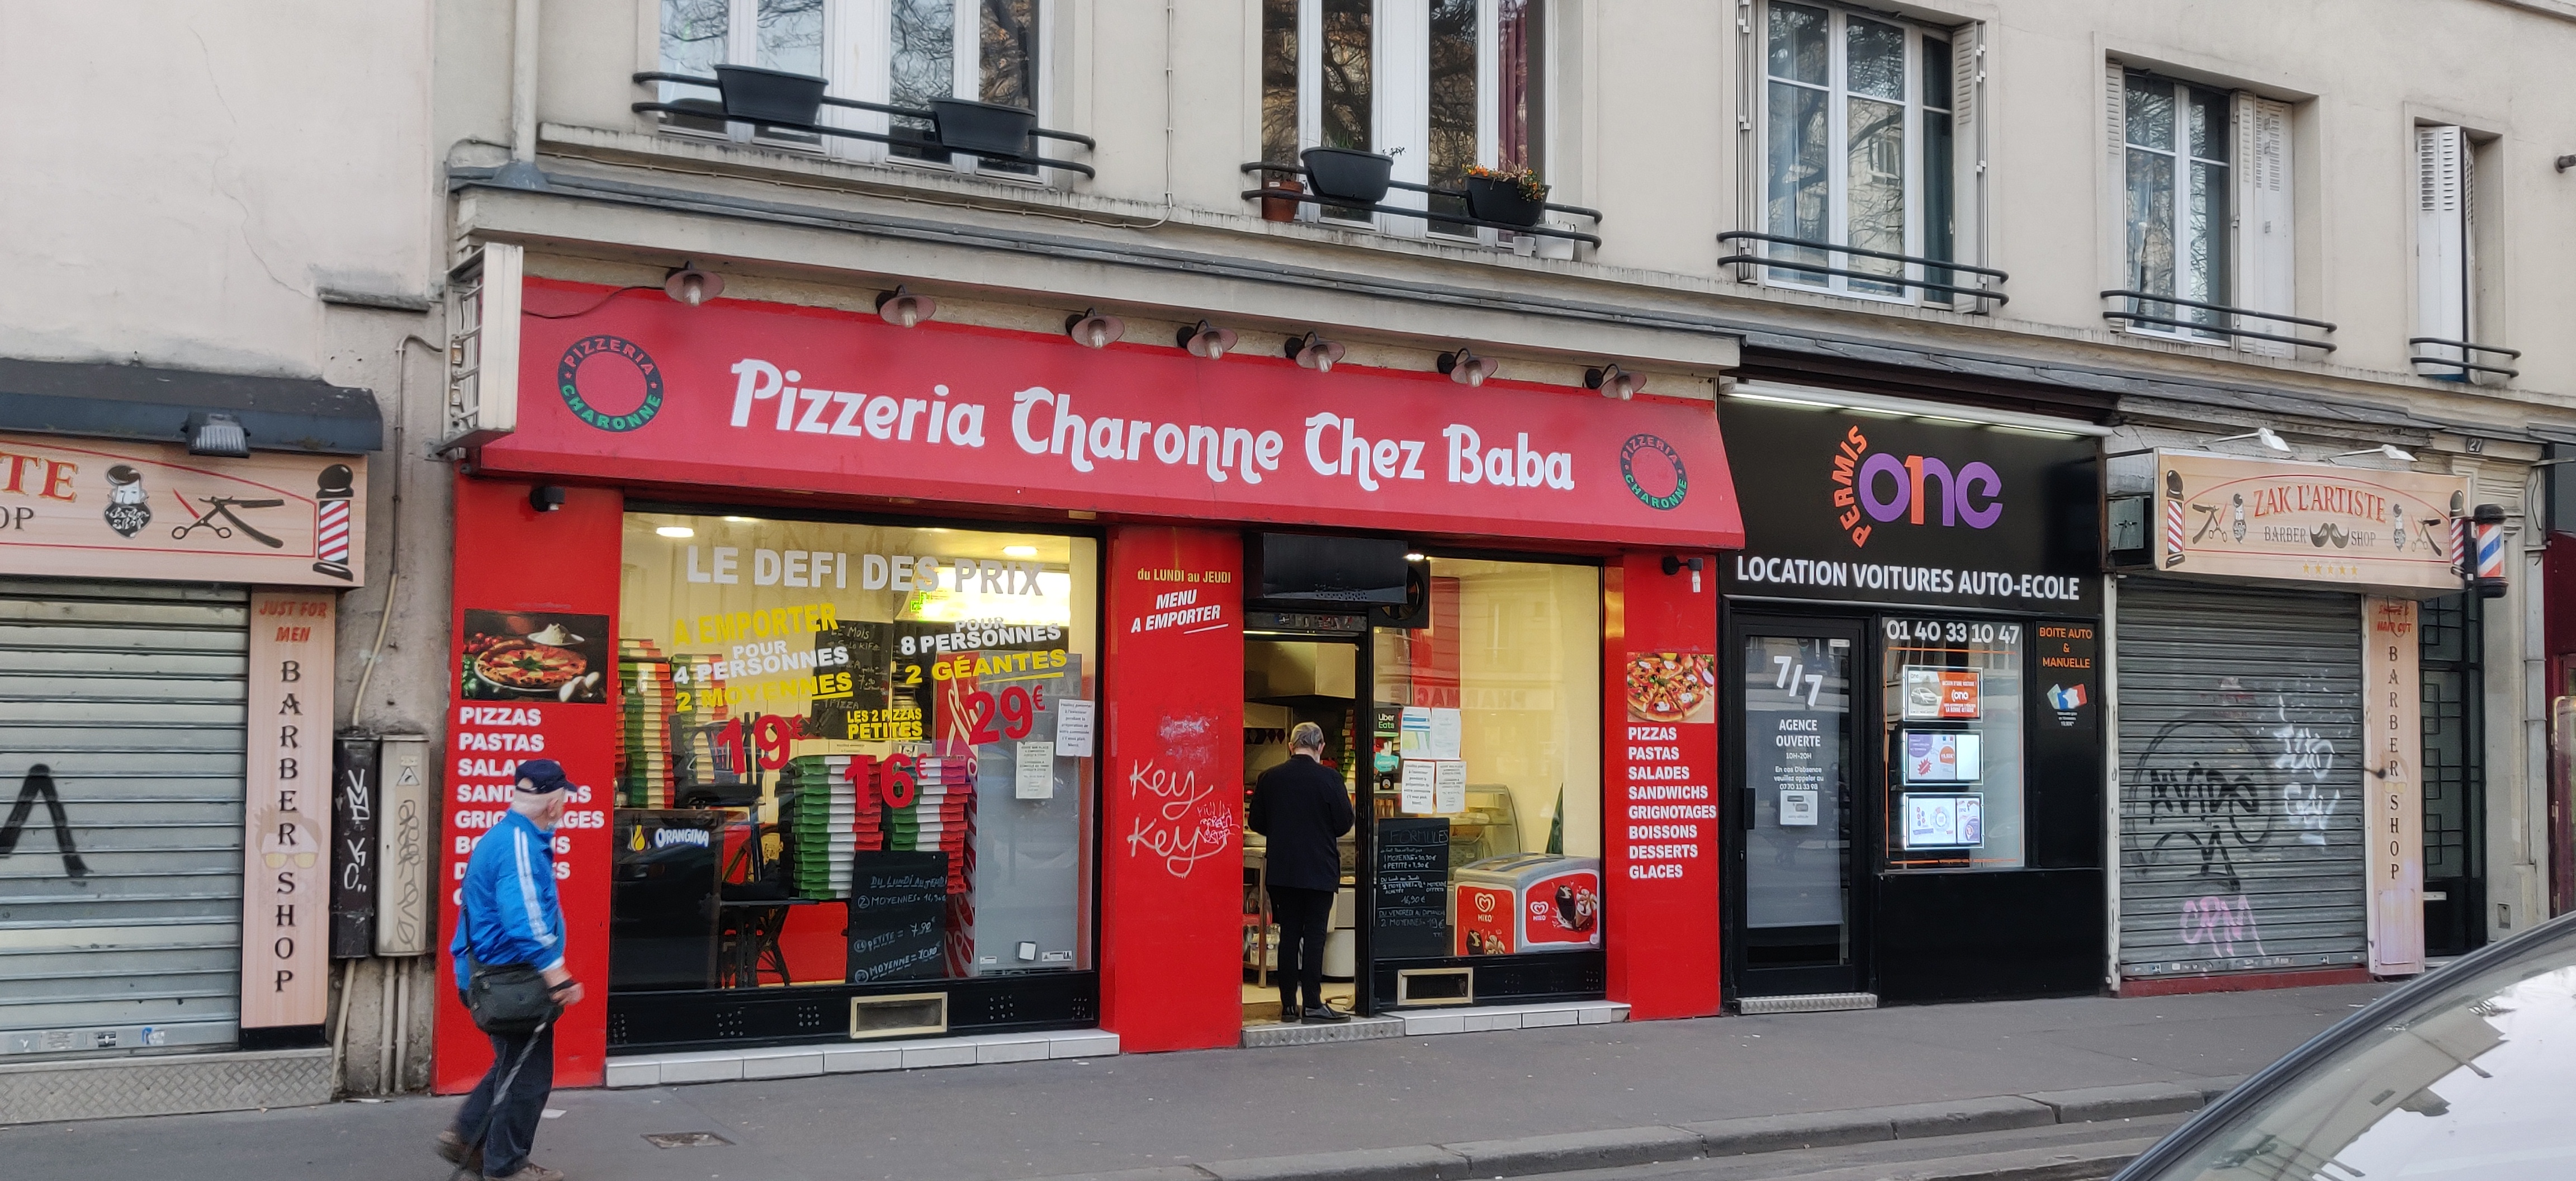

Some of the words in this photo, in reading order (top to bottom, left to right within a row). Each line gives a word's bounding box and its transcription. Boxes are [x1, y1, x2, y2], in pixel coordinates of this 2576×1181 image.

[564, 338, 654, 375] PIZZERIA
[561, 384, 661, 430] CHARONNE
[730, 358, 985, 447] Pizzeria
[1011, 386, 1284, 484] Charonne
[1304, 412, 1426, 492] Chez
[1442, 423, 1575, 491] Baba
[1622, 436, 1678, 464] PIZZERIA
[2469, 438, 2483, 452] 27
[1625, 474, 1687, 508] CHARONNE
[1831, 425, 1872, 548] PERMIS
[2253, 485, 2293, 519] ZAK
[2296, 484, 2386, 524] L'ARTISTE
[2264, 526, 2308, 544] BARBER
[2351, 531, 2376, 547] SHOP
[687, 545, 739, 585] LE
[754, 548, 846, 589] DEFI
[862, 553, 939, 592] DES
[954, 558, 1045, 596] PRIX
[1137, 568, 1150, 580] du
[1153, 569, 1185, 582] LUNDI
[1187, 572, 1200, 583] au
[1202, 571, 1232, 584] JEUDI
[1737, 555, 1847, 587] LOCATION
[1852, 563, 1954, 593] VOITURES
[1958, 570, 2080, 601] AUTO-ECOLE
[1156, 589, 1197, 610] MENU
[259, 601, 296, 616] JUST
[299, 601, 328, 618] FOR
[1130, 617, 1142, 634] A
[1145, 604, 1221, 631] EMPORTER
[674, 619, 692, 646] A
[698, 603, 839, 644] EMPORTER
[955, 617, 1005, 632] POUR
[1886, 620, 1911, 640] 01
[1915, 621, 1941, 641] 40
[1945, 622, 1967, 643] 33
[1971, 623, 1994, 643] 10
[1998, 625, 2020, 644] 47
[2039, 627, 2067, 639] BOITE
[2068, 628, 2093, 640] AUTO
[275, 626, 311, 643] MEN
[901, 636, 916, 655] 8
[920, 623, 1062, 653] PERSONNES
[732, 640, 788, 659] POUR
[2063, 643, 2071, 653] &
[673, 665, 690, 684] 4
[697, 646, 849, 682] PERSONNES
[905, 665, 922, 685] 2
[932, 649, 1067, 682] GÉANTES
[2042, 656, 2091, 669] MANUELLE
[1773, 655, 1823, 707] 7/7
[676, 692, 693, 712] 2
[701, 672, 853, 708] MOYENNES
[460, 707, 542, 727] PIZZAS
[846, 710, 869, 724] LES
[872, 711, 879, 723] 2
[881, 708, 922, 723] PIZZAS
[1378, 713, 1395, 721] Uber
[2388, 645, 2399, 777] BARBER
[847, 721, 923, 740] PETITES
[1628, 726, 1677, 741] PIZZAS
[1778, 719, 1818, 731] AGENCE
[458, 733, 544, 752] PASTAS
[1775, 734, 1821, 748] OUVERTE
[280, 660, 302, 846] BARBER
[1628, 746, 1680, 760] PASTAS
[1628, 766, 1690, 780] SALADES
[1628, 785, 1708, 800] SANDWICHS
[1628, 805, 1717, 820] GRIGNOTAGES
[655, 828, 710, 848] ORANGINA
[1390, 829, 1449, 844] FORMULES
[1629, 824, 1698, 840] BOISSONS
[2389, 794, 2400, 881] SHOP
[1629, 844, 1698, 859] DESSERTS
[1629, 864, 1683, 880] GLACES
[1380, 918, 1387, 928] 2
[1478, 914, 1493, 923] MIKO
[273, 871, 297, 993] SHOP
